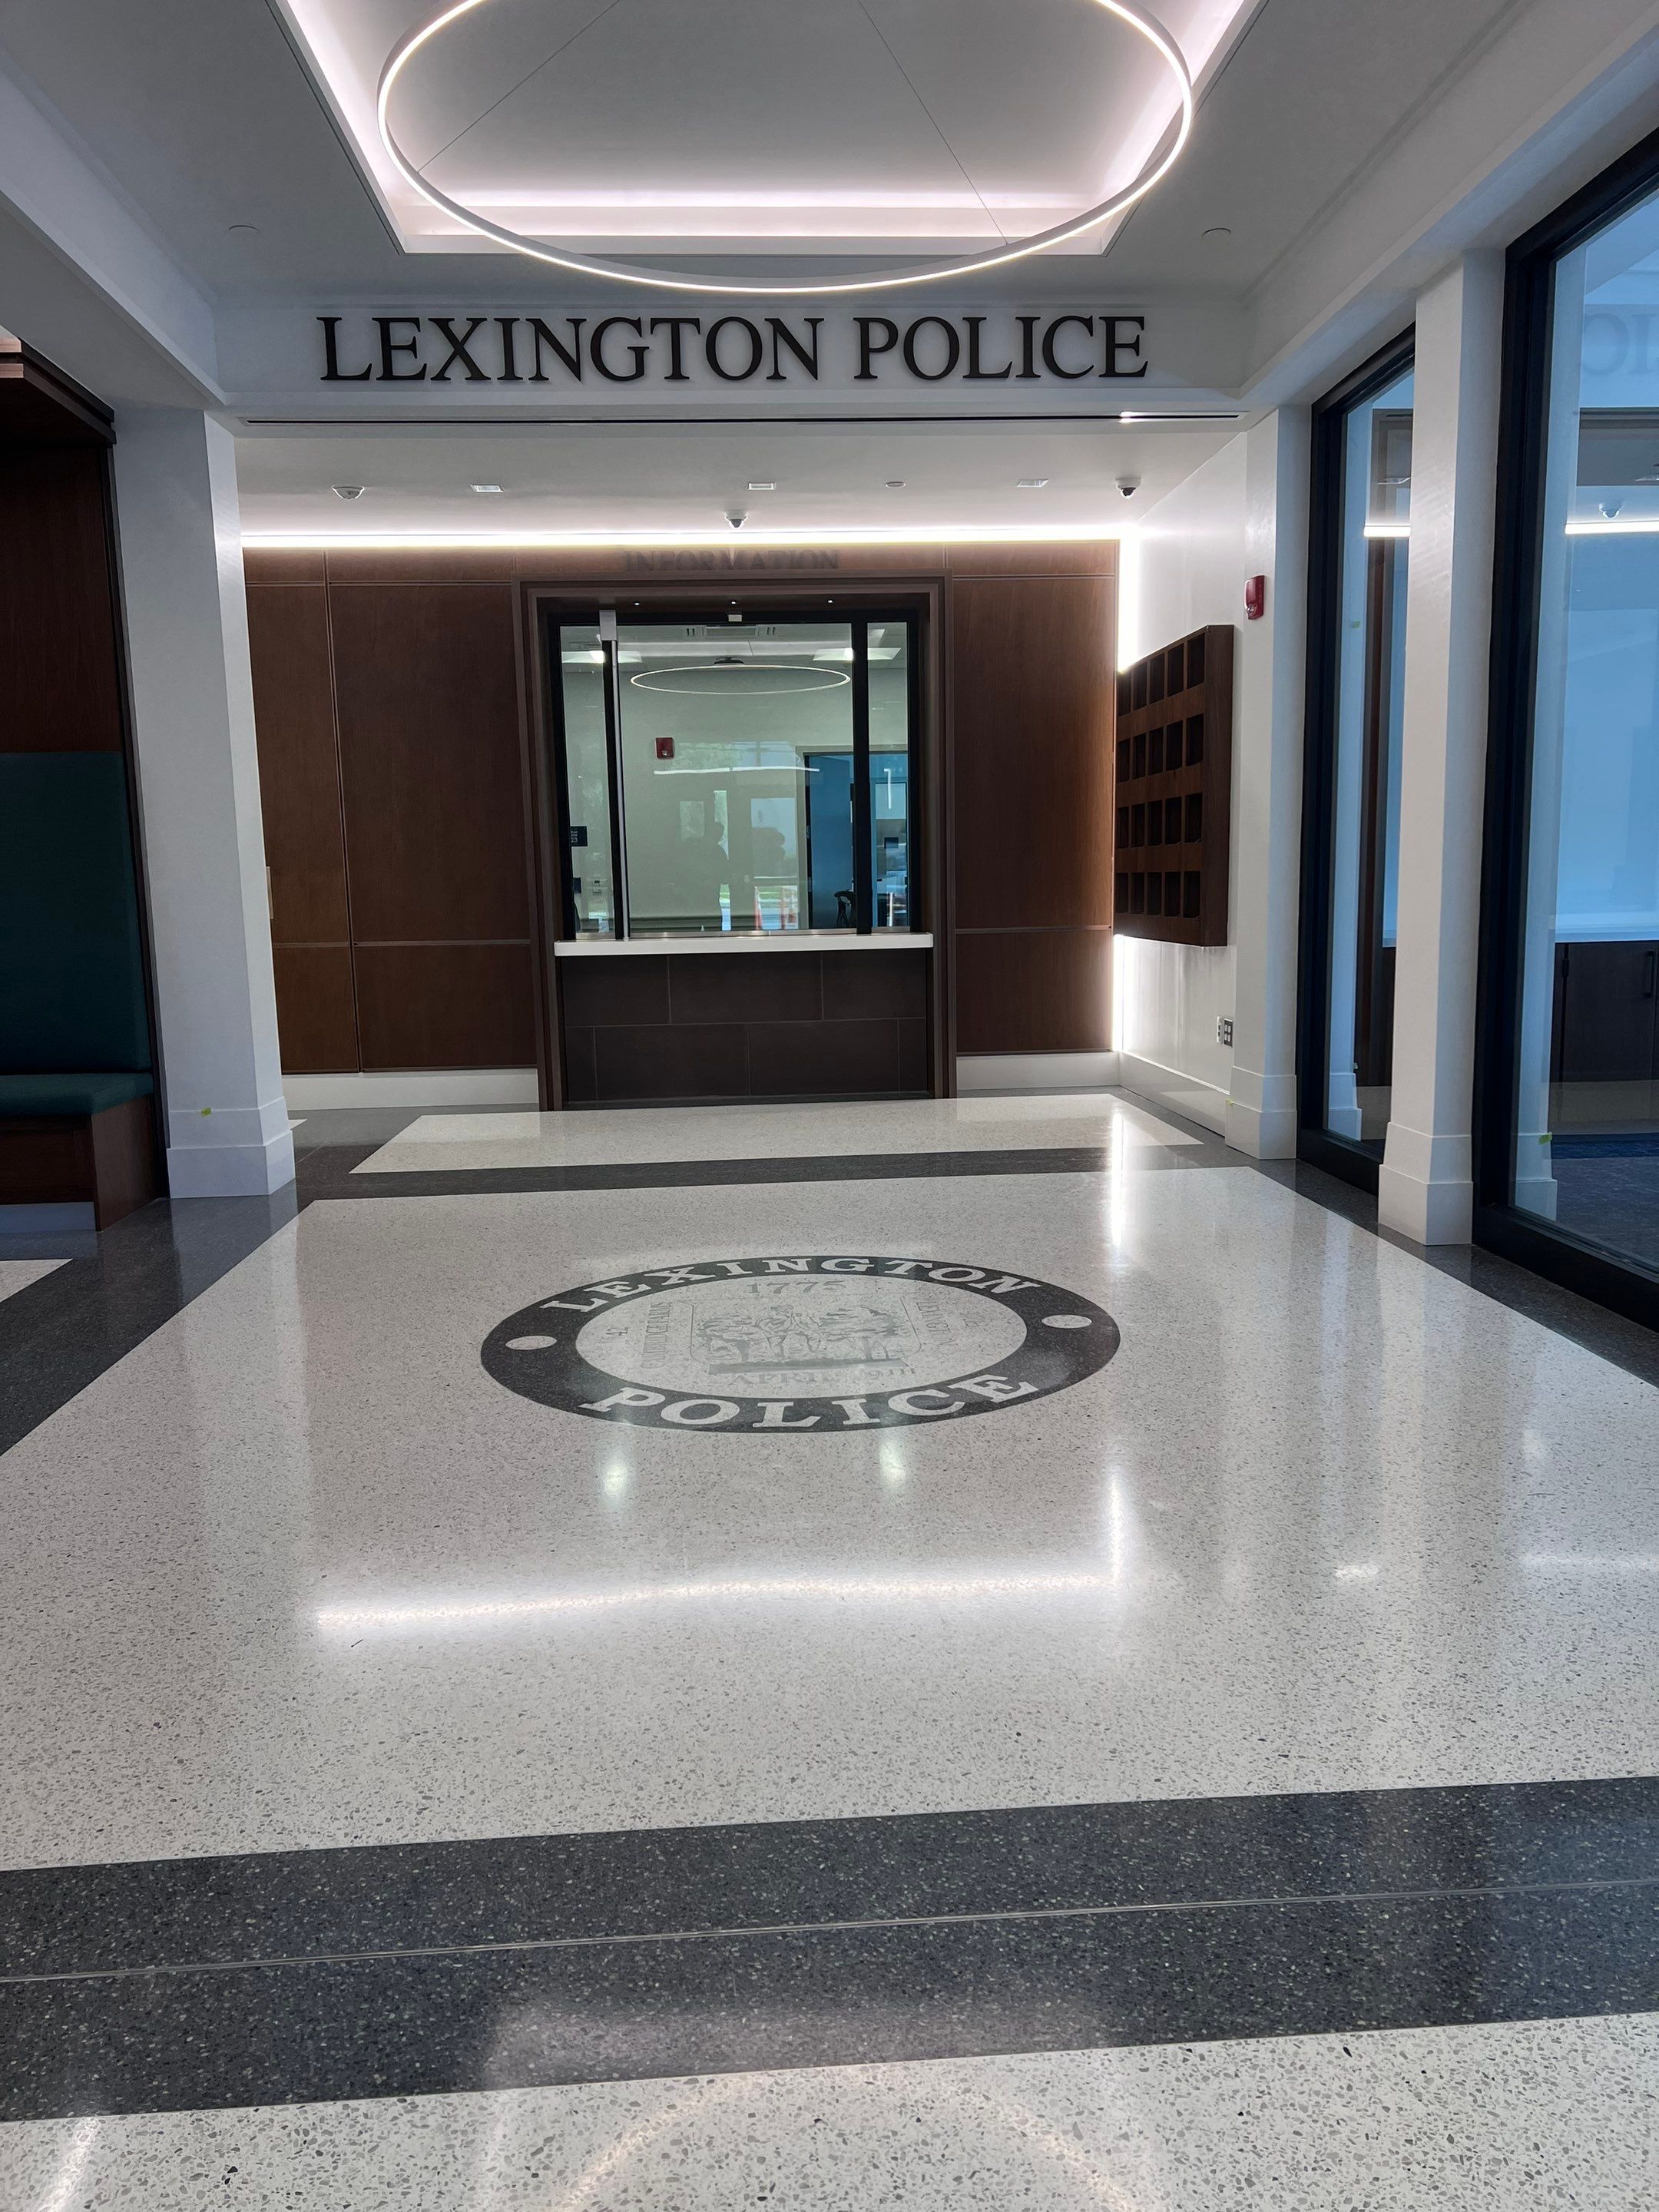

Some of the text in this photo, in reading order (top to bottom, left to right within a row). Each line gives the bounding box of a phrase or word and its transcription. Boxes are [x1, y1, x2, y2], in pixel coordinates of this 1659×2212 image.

[316, 315, 1150, 382] LEXINGTON POLICE
[622, 550, 842, 571] INFORMATION
[539, 1257, 1041, 1312] LEXINGTON
[747, 1280, 846, 1294] 1775
[578, 1374, 1039, 1429] POLICE
